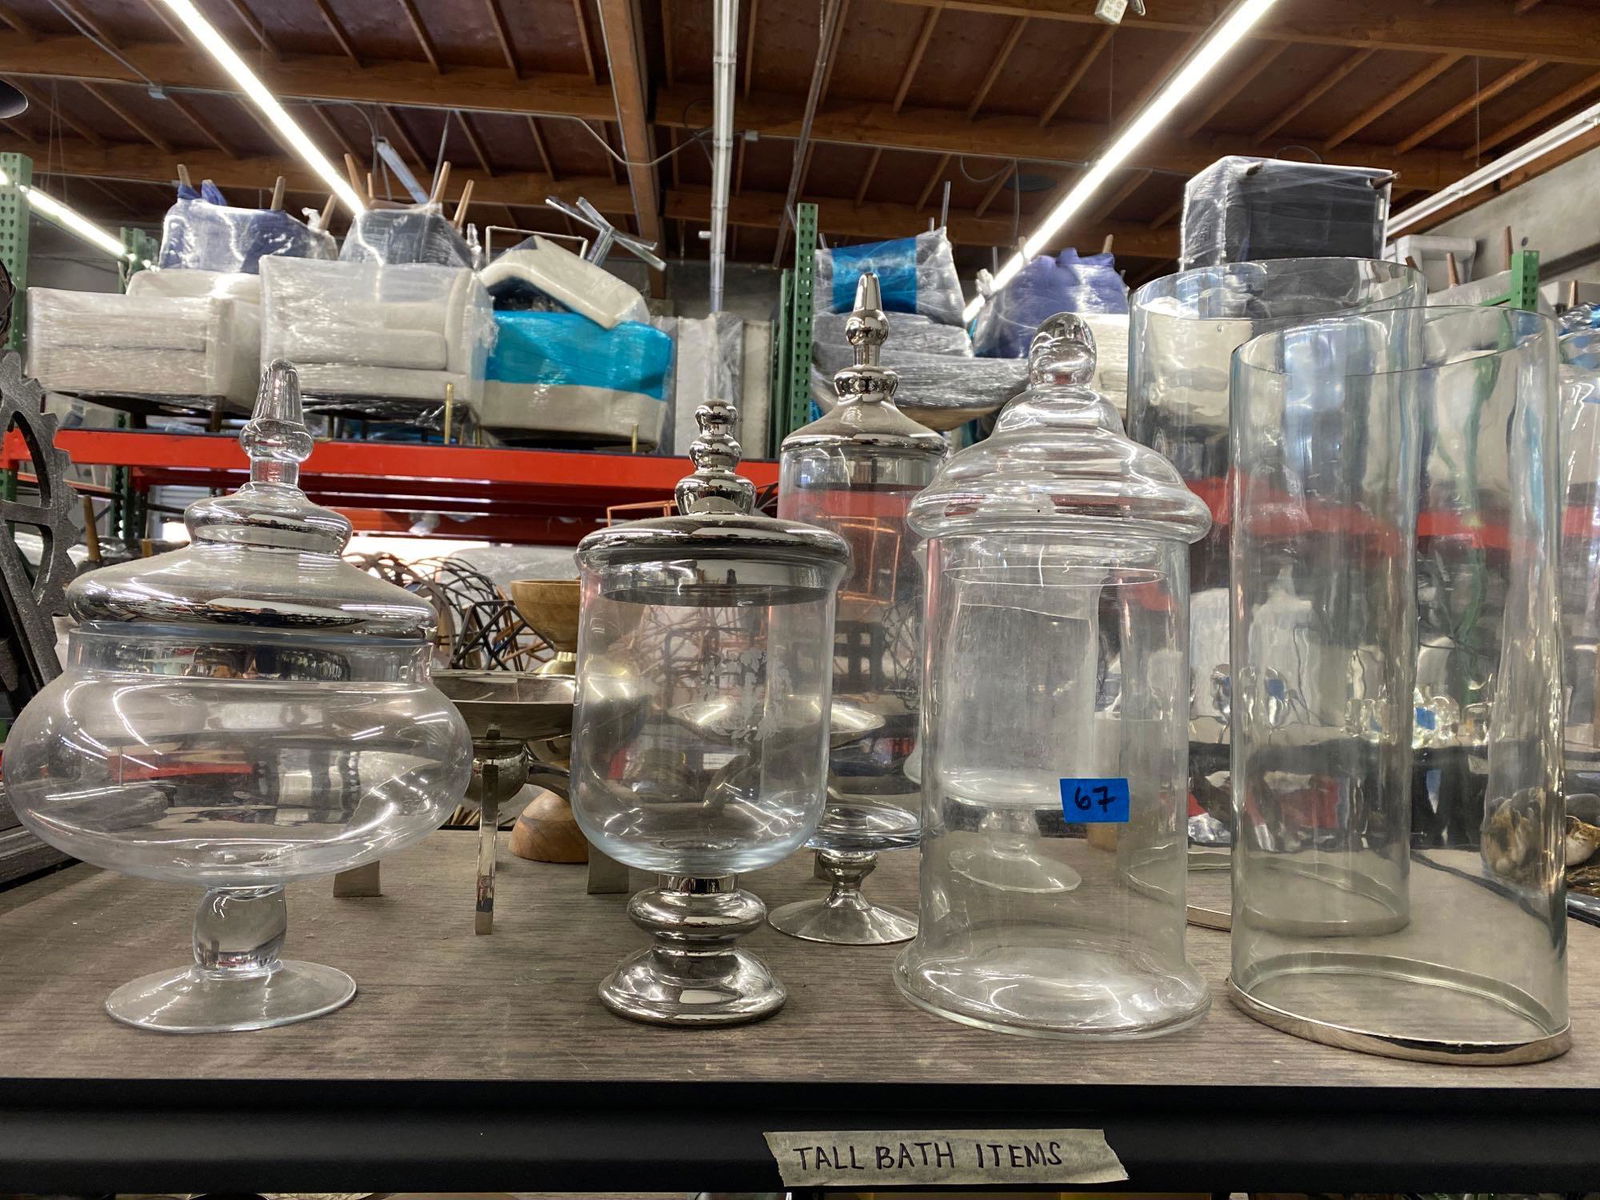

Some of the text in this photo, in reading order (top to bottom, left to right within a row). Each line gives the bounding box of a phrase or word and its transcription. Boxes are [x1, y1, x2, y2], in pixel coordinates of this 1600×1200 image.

[1074, 785, 1117, 813] 67
[792, 1141, 1063, 1171] TALL BATH ITEMS
